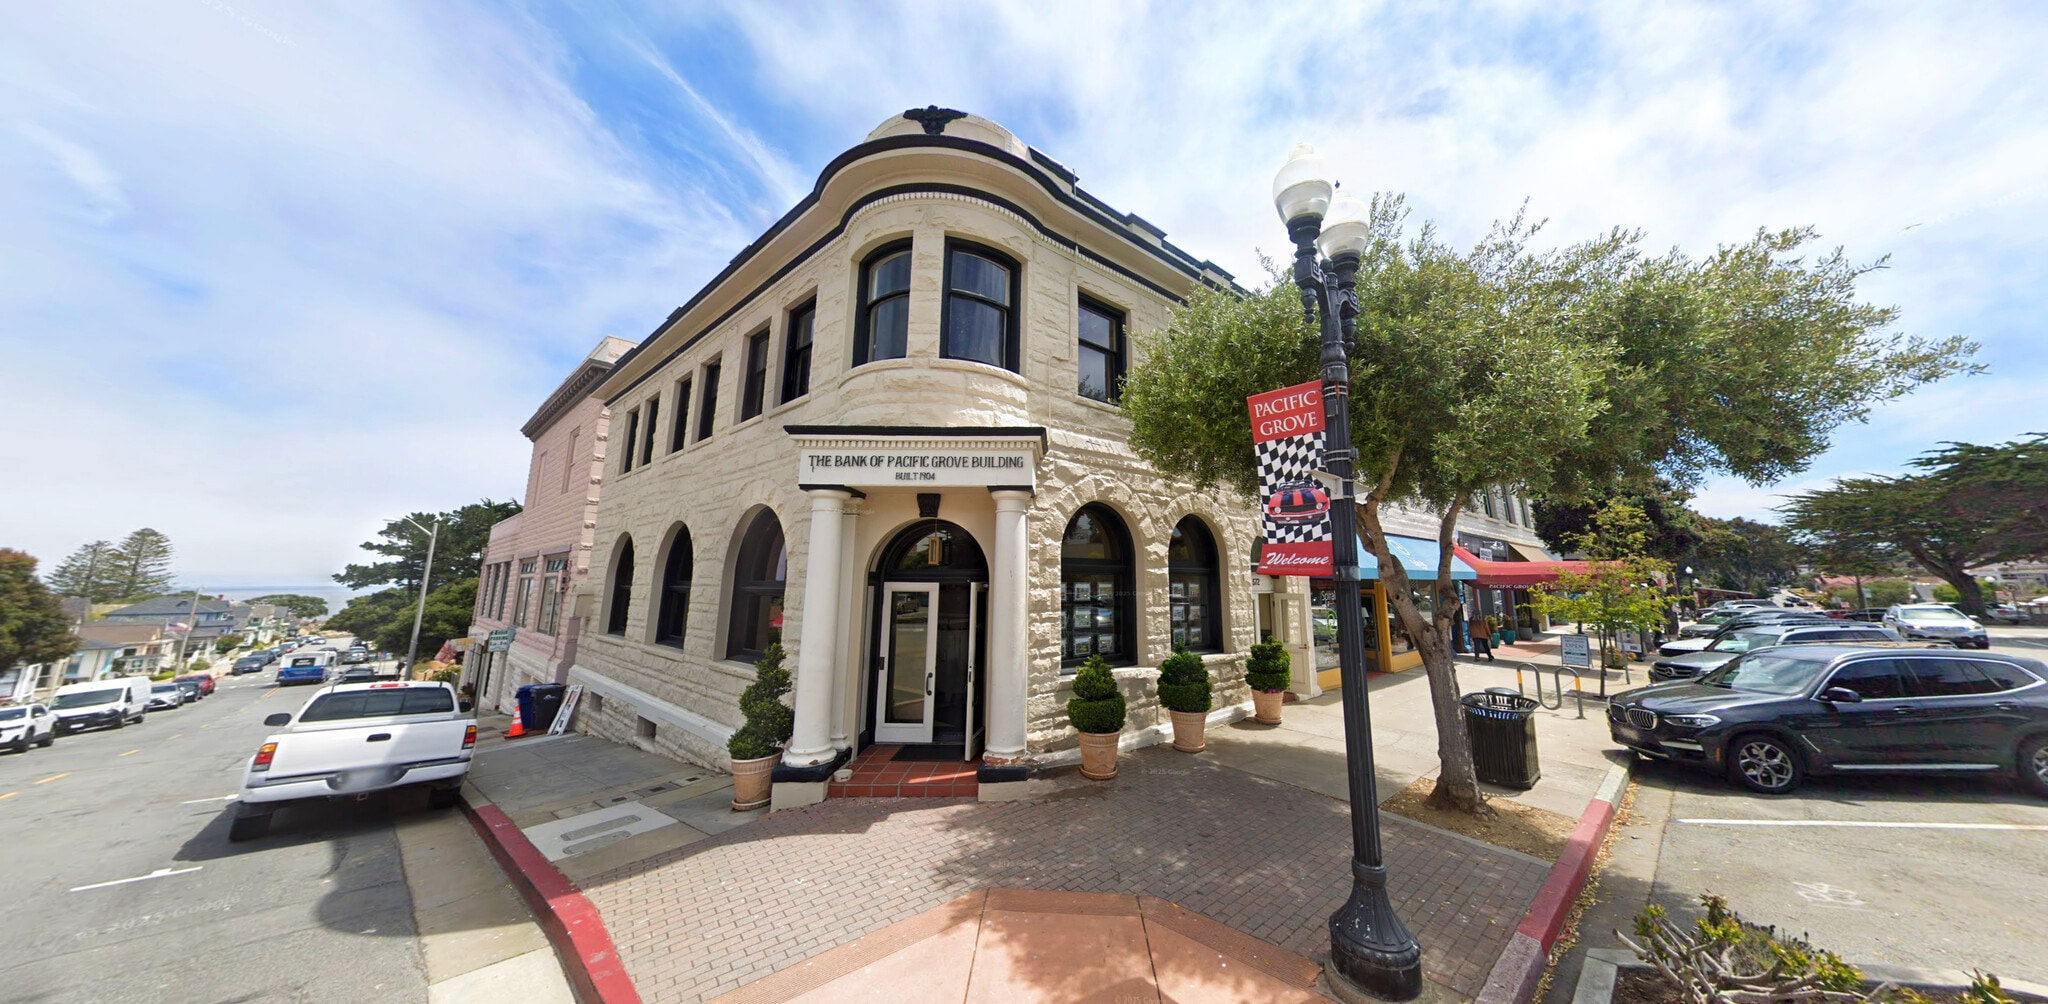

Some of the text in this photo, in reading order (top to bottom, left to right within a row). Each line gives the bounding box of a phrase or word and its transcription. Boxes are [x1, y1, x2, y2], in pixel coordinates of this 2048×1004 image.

[1254, 390, 1318, 418] PACIFIC
[1259, 411, 1318, 436] GROVE
[808, 455, 1024, 468] THE BANK OF PACIFIC GROVE BUILDING
[895, 472, 935, 480] BUILT 1904
[1266, 552, 1330, 566] Welcome
